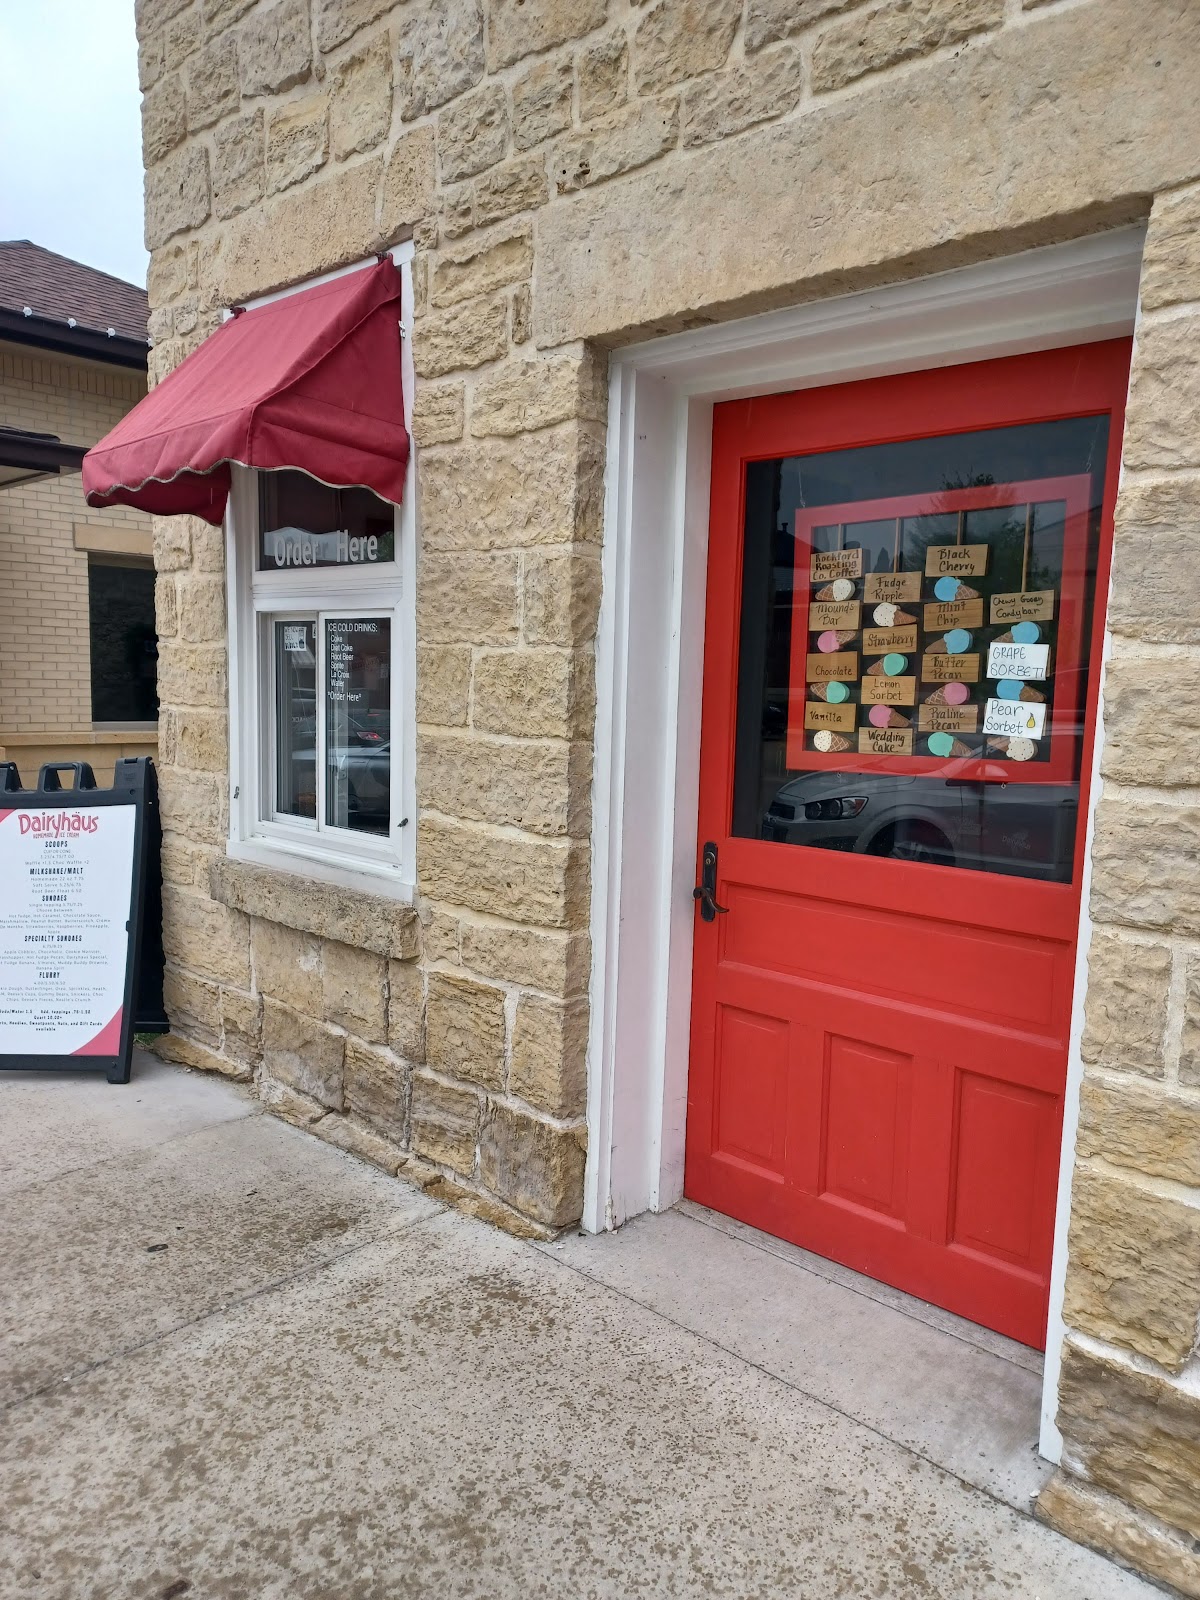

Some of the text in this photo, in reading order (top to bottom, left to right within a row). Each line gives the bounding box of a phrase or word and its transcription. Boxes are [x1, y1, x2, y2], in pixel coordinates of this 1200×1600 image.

[274, 530, 377, 566] Order Here
[938, 548, 970, 559] Black
[815, 551, 860, 562] Rockford
[816, 560, 857, 571] Roasting
[939, 561, 975, 575] Cherry
[813, 568, 859, 580] Co. Coffee
[877, 577, 907, 588] Fudge
[872, 589, 904, 602] Ripple
[993, 595, 1043, 606] Chewy Gooey
[816, 602, 854, 613] Mounds
[937, 602, 966, 612] Mint
[820, 615, 841, 626] Bar
[937, 614, 959, 626] Chip
[338, 624, 352, 632] COLD
[354, 623, 377, 632] DRINKS:
[868, 633, 914, 647] Strawberry
[993, 647, 1026, 659] GRAPE
[331, 662, 344, 670] Sprite
[932, 657, 966, 667] Butter
[815, 666, 852, 676] Chocolate
[931, 668, 962, 679] Pecan
[873, 678, 900, 688] Lemon
[870, 688, 902, 701] Sorbet
[930, 707, 965, 719] Praline
[992, 700, 1023, 716] Pear
[810, 711, 842, 722] Vanilla
[927, 719, 960, 730] Pecan
[986, 718, 1023, 734] Sorbet
[868, 730, 905, 747] Wedding
[872, 741, 895, 753] Cake
[18, 812, 99, 838] Dairyhäus
